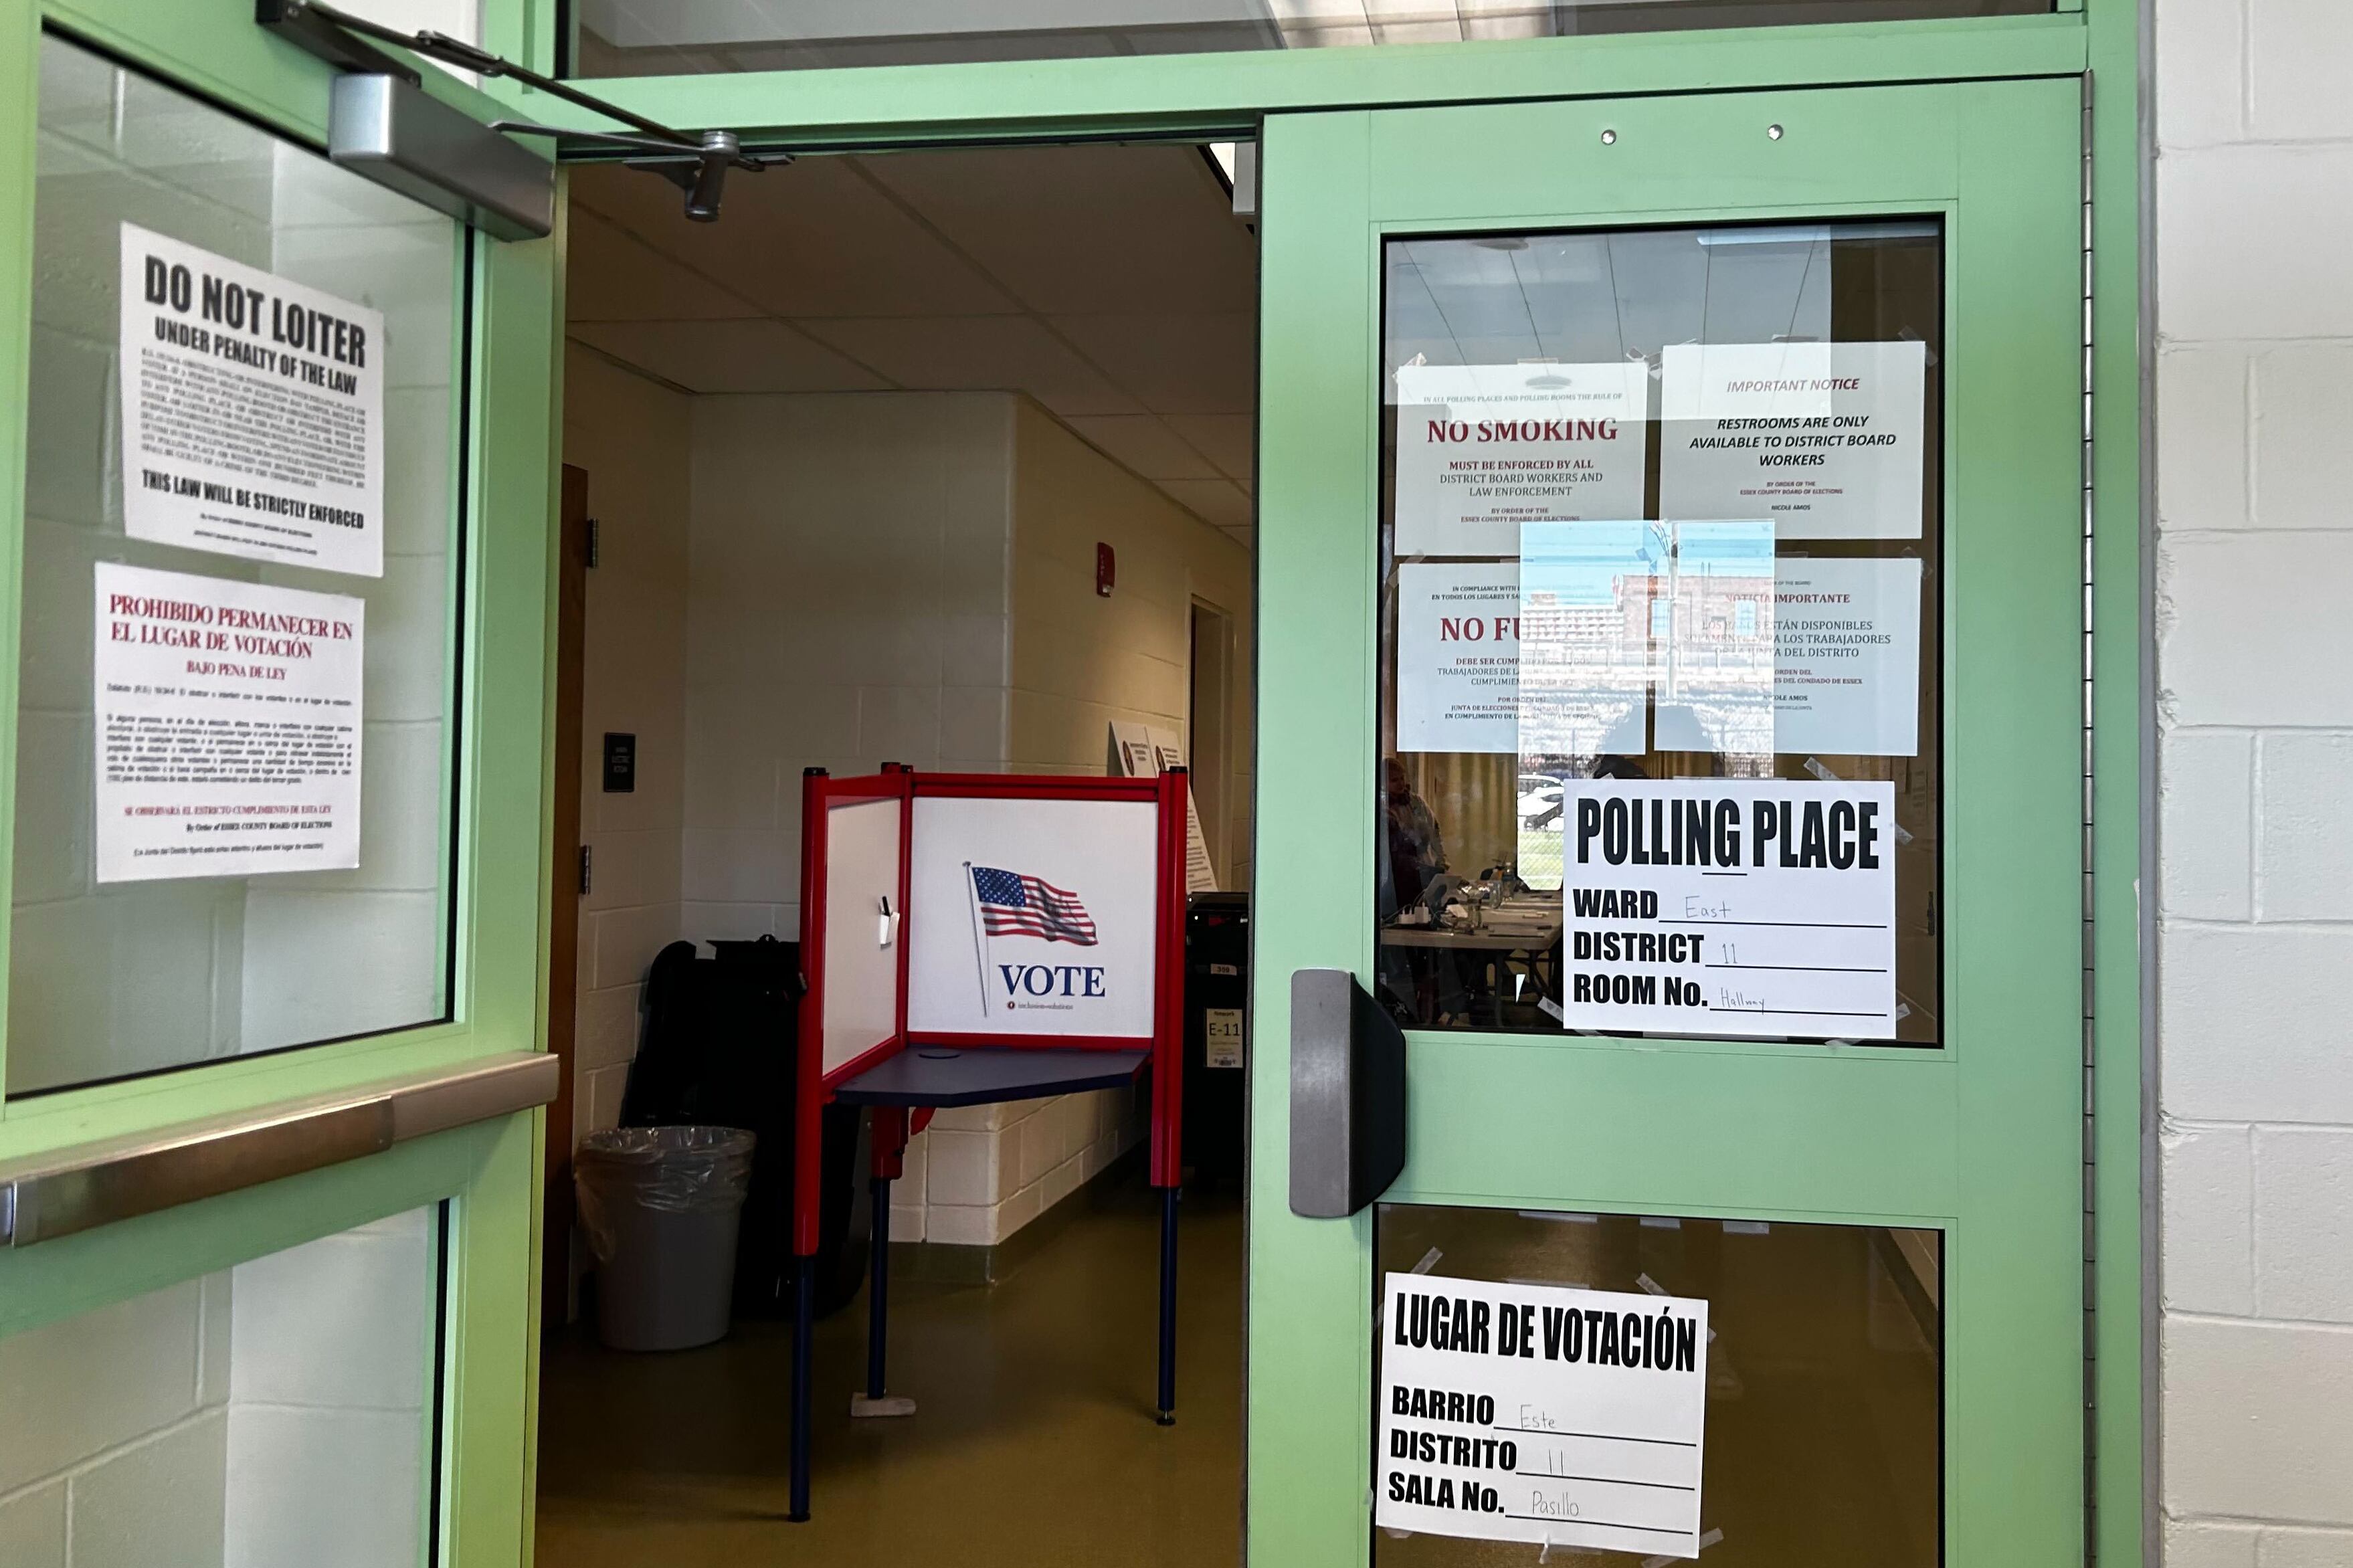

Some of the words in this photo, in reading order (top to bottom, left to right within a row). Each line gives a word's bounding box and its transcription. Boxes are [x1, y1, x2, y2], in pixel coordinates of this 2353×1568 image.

[145, 254, 191, 313] DO
[202, 273, 264, 334] NOT
[273, 297, 365, 368] LOITER
[155, 316, 210, 353] UNDER
[214, 330, 277, 373] PENALTY
[280, 355, 298, 378] OF
[300, 360, 326, 387] THE
[328, 369, 357, 396] LAW
[1727, 380, 1807, 393] IMPORTANT
[1810, 379, 1860, 391] NOTICE
[1427, 420, 1469, 443] NO
[1478, 418, 1618, 442] SMOKING
[1717, 417, 1800, 429] RESTROOMS
[1802, 417, 1829, 428] ARE
[1832, 416, 1869, 428] ONLY
[1689, 436, 1760, 448] AVAILABLE
[1764, 436, 1781, 448] TO
[1785, 435, 1845, 447] DISTRICT
[1847, 434, 1896, 446] BOARD
[1450, 462, 1480, 470] MUST
[1481, 461, 1495, 470] BE
[1498, 460, 1554, 469] ENFORCED
[1556, 460, 1571, 469] BY
[1573, 460, 1594, 468] ALL
[1759, 455, 1824, 466] WORKERS
[1440, 474, 1486, 484] DISTRICT
[1489, 474, 1524, 483] BOARD
[1526, 474, 1578, 482] WORKERS
[1580, 473, 1602, 482] AND
[1469, 488, 1493, 496] LAW
[1495, 486, 1572, 496] ENFORCEMENT
[143, 469, 170, 493] THIS
[173, 477, 201, 499] LAW
[204, 484, 234, 505] WILL
[236, 490, 252, 509] BE
[254, 492, 306, 518] STRICTLY
[309, 502, 364, 529] ENFORCED
[1774, 593, 1850, 604] IMPORTANTE
[109, 594, 213, 625] PROHIBIDO
[217, 607, 329, 639] PERMANECER
[333, 621, 353, 640] EN
[1440, 617, 1484, 641] NO
[1802, 620, 1873, 631] DISPONIBLES
[111, 622, 136, 643] EL
[140, 626, 201, 650] LUGAR
[206, 631, 231, 652] DE
[233, 636, 313, 659] VOTACIÓN
[1784, 634, 1804, 644] LOS
[1806, 634, 1891, 644] TRABAJADORES
[1784, 648, 1805, 658] DEL
[1808, 648, 1859, 658] DISTRITO
[186, 660, 215, 675] BAJO
[218, 663, 246, 678] PENA
[250, 666, 265, 678] DE
[266, 668, 288, 680] LEY
[1438, 668, 1498, 676] TRABAJADORES
[1578, 798, 1740, 867] POLLING
[1753, 800, 1879, 870] PLACE
[1573, 888, 1658, 918] WARD
[1685, 895, 1732, 918] East
[1574, 932, 1704, 963] DISTRICT
[1722, 943, 1737, 964] 11
[998, 965, 1105, 997] VOTE
[1574, 974, 1656, 1005] ROOM
[1664, 977, 1708, 1006] No.
[1720, 987, 1765, 1015] Hallway
[1209, 1023, 1240, 1036] E-11
[1396, 1292, 1490, 1355] LUGAR
[1498, 1302, 1535, 1359] DE
[1543, 1306, 1696, 1373] VOTACIÓN
[1392, 1385, 1495, 1425] BARRIO
[1520, 1404, 1557, 1429] Este
[1390, 1429, 1517, 1471] DISTRITO
[1547, 1449, 1564, 1476] 11
[1388, 1472, 1455, 1508] SALA
[1462, 1481, 1505, 1513] No.
[1531, 1490, 1580, 1516] Pasillo
